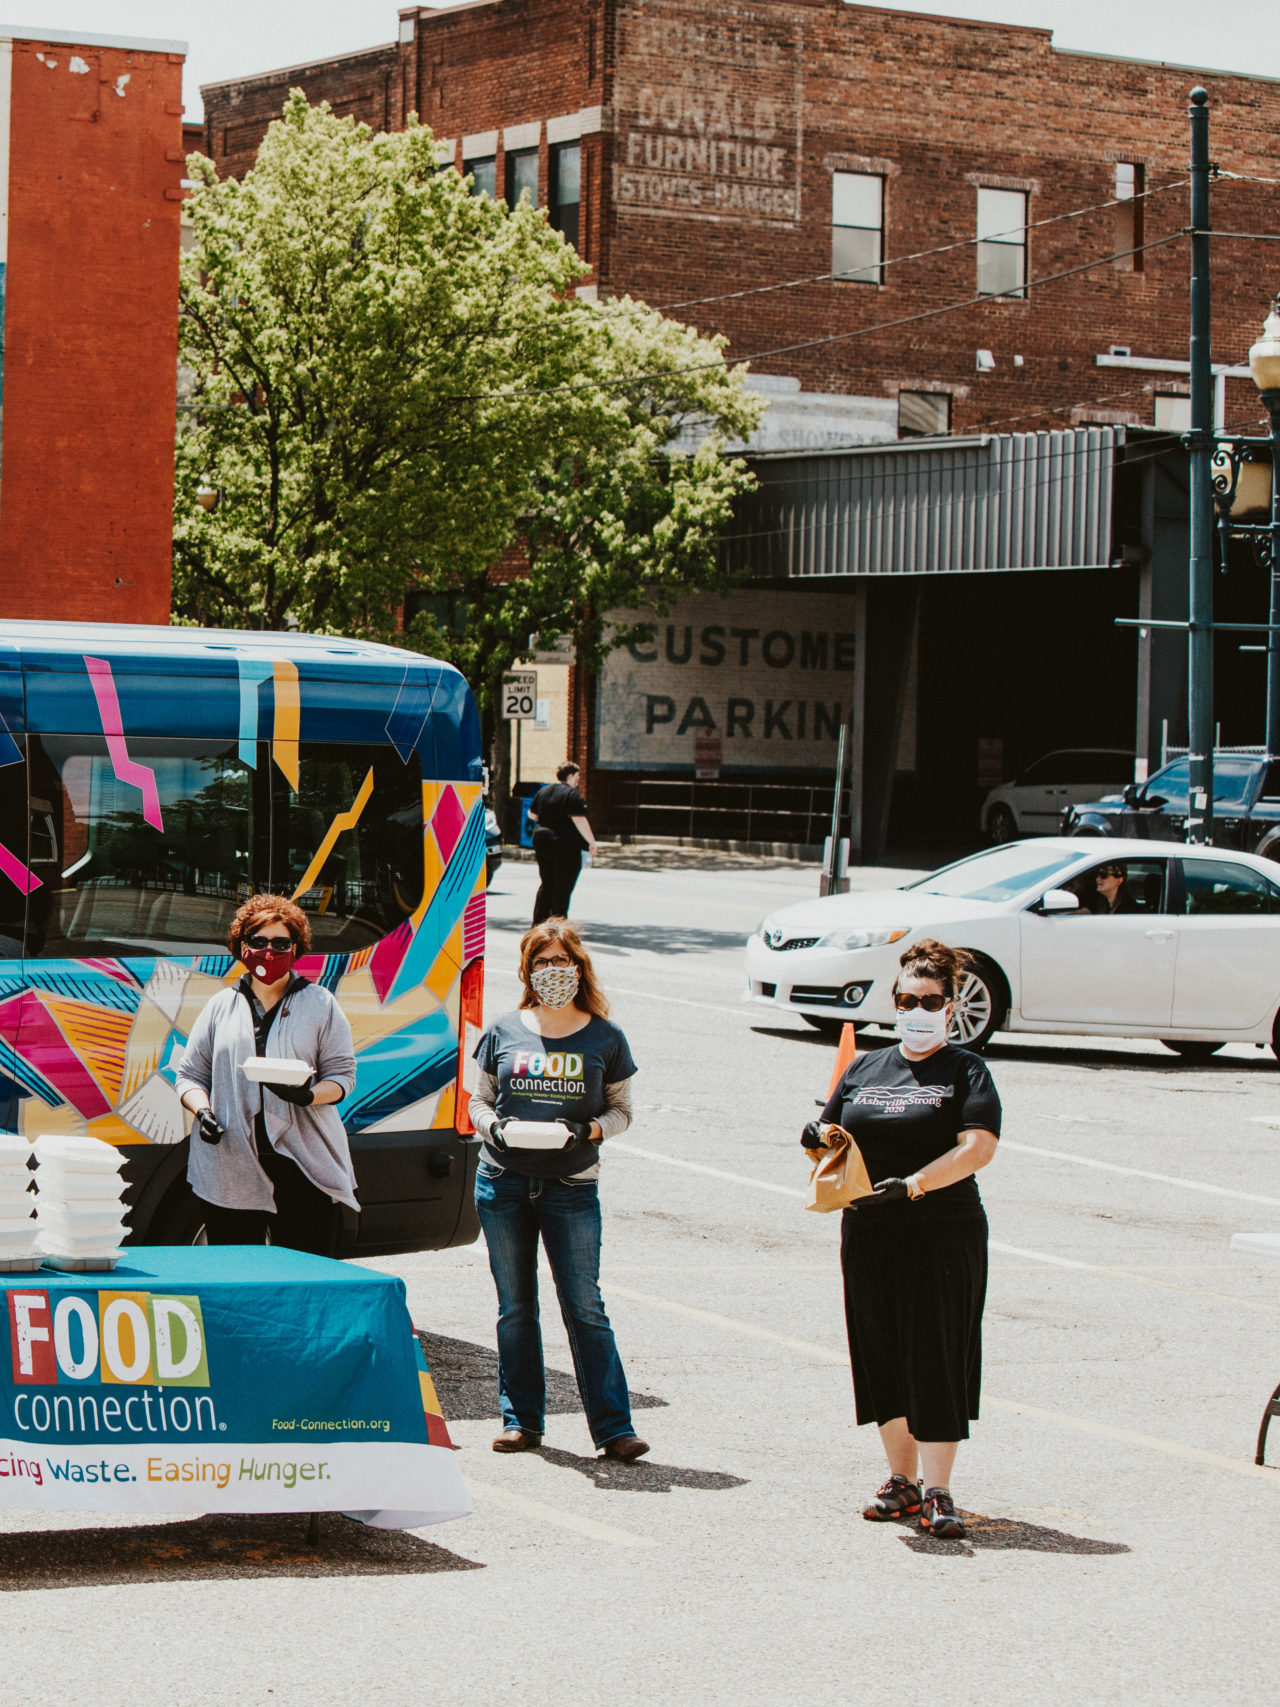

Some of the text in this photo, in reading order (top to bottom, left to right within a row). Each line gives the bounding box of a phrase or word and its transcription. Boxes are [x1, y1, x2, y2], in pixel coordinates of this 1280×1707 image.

[627, 132, 787, 181] FURNITURE
[627, 622, 856, 672] CUSTOME
[505, 676, 534, 684] EED
[508, 686, 531, 694] LIMIT
[506, 696, 533, 714] 20
[645, 695, 854, 741] PARKIN
[513, 1051, 584, 1078] FOOD
[852, 1095, 942, 1108] #AshevilleStrong
[883, 1105, 906, 1114] 2020
[13, 1293, 204, 1384] FOOD
[271, 1418, 391, 1432] Food-Connection.org
[45, 1457, 138, 1484] Waste.
[146, 1456, 232, 1489] Easing
[238, 1457, 332, 1489] Hunger.
